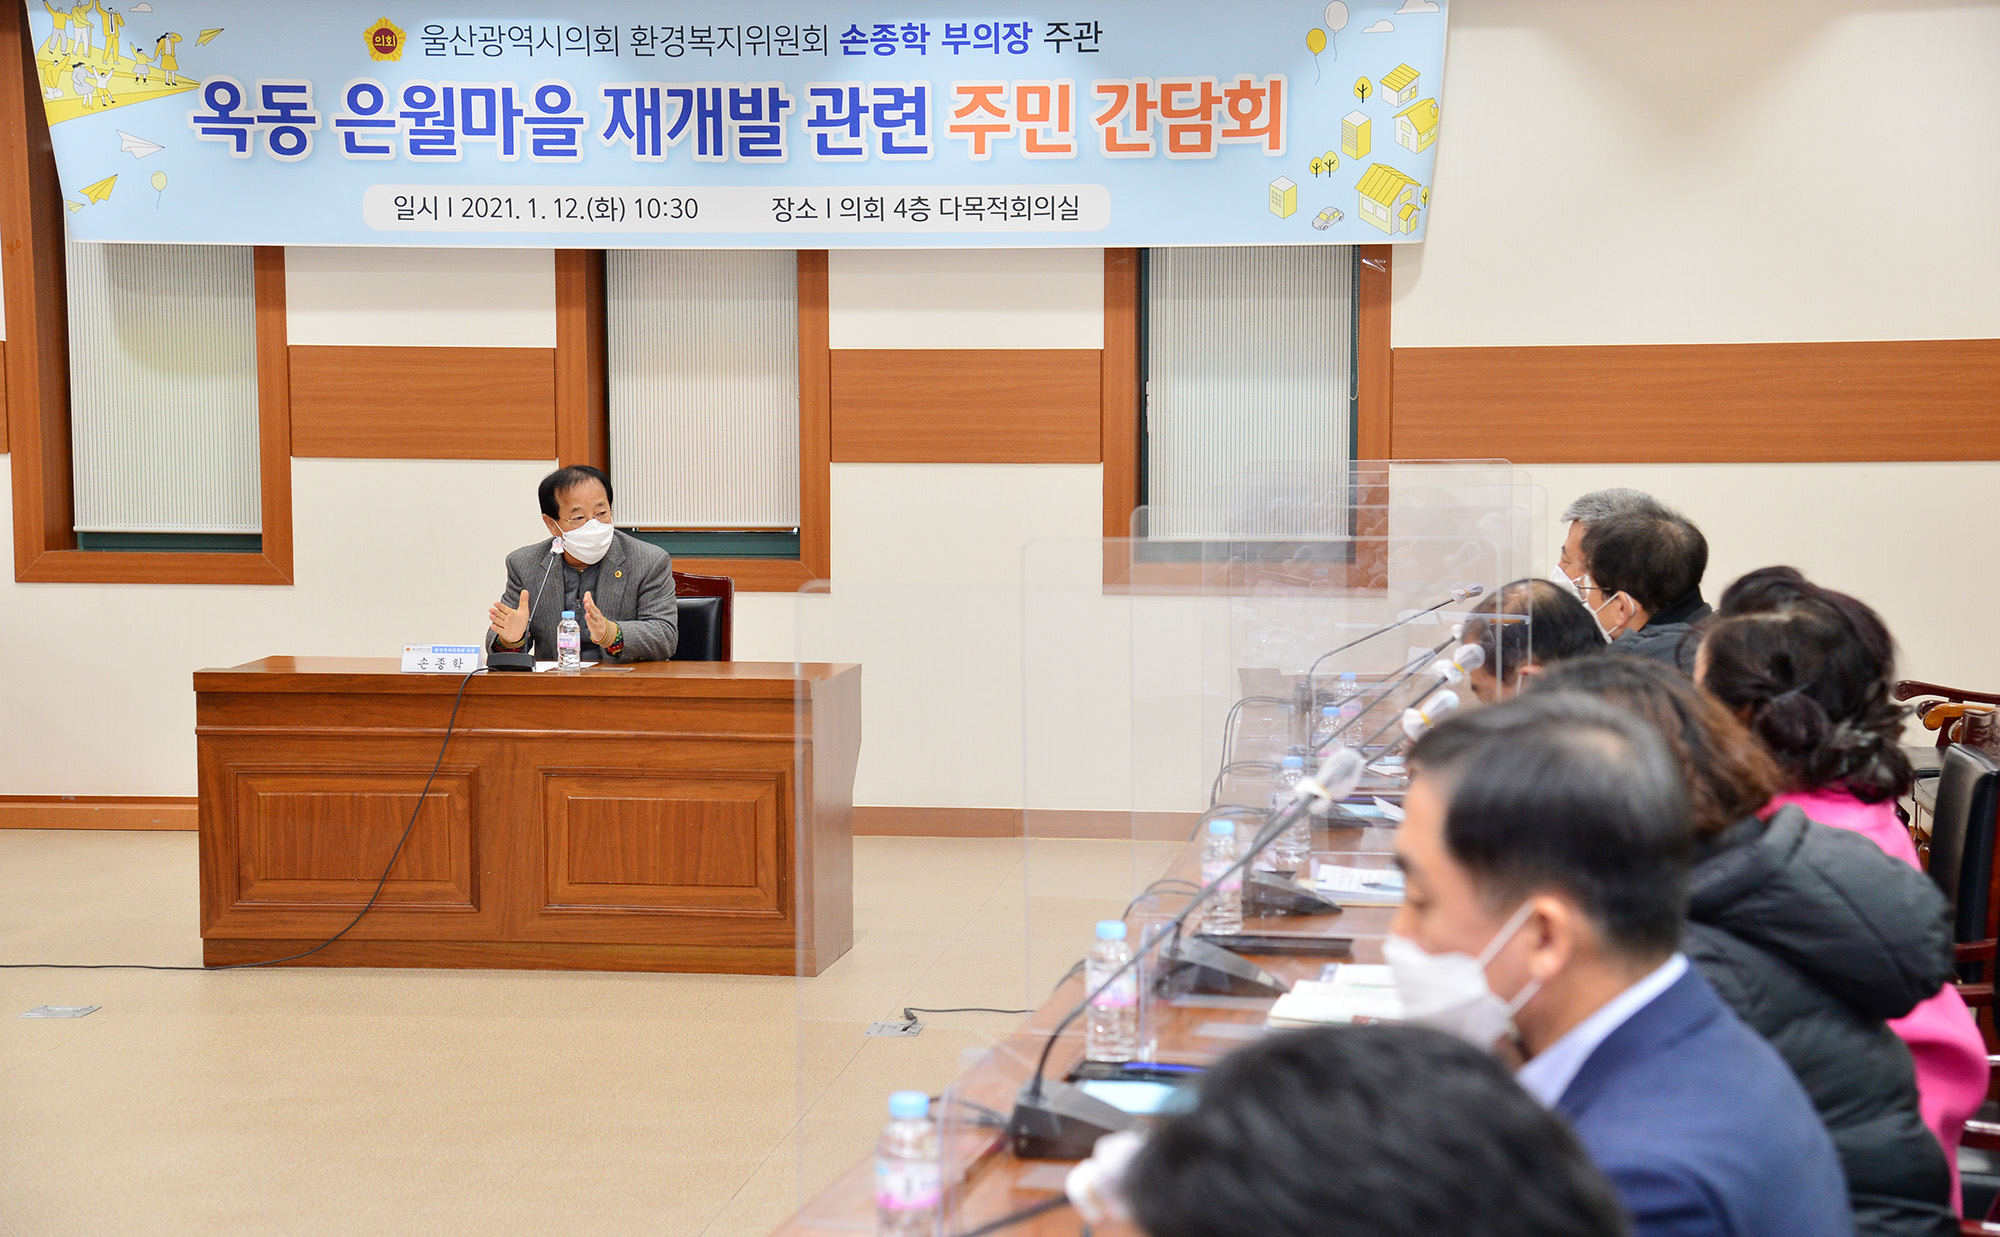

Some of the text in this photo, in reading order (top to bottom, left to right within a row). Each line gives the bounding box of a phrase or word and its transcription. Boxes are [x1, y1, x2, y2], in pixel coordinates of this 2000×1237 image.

[374, 34, 396, 47] 의회
[420, 20, 1104, 58] 울산광역시의회 환경복지위원회 손종학 부의장 주관
[192, 79, 1282, 158] 옥동 은월마을 재개발 관련 주민 간담회
[393, 195, 438, 221] 일시
[461, 197, 520, 220] 2021.
[528, 197, 546, 220] 1.
[553, 196, 626, 223] 12.(화)
[634, 197, 699, 219] 10:30
[771, 196, 819, 223] 장소
[839, 196, 884, 222] 의회
[893, 195, 932, 223] 4층
[939, 195, 1079, 222] 다목적회의실
